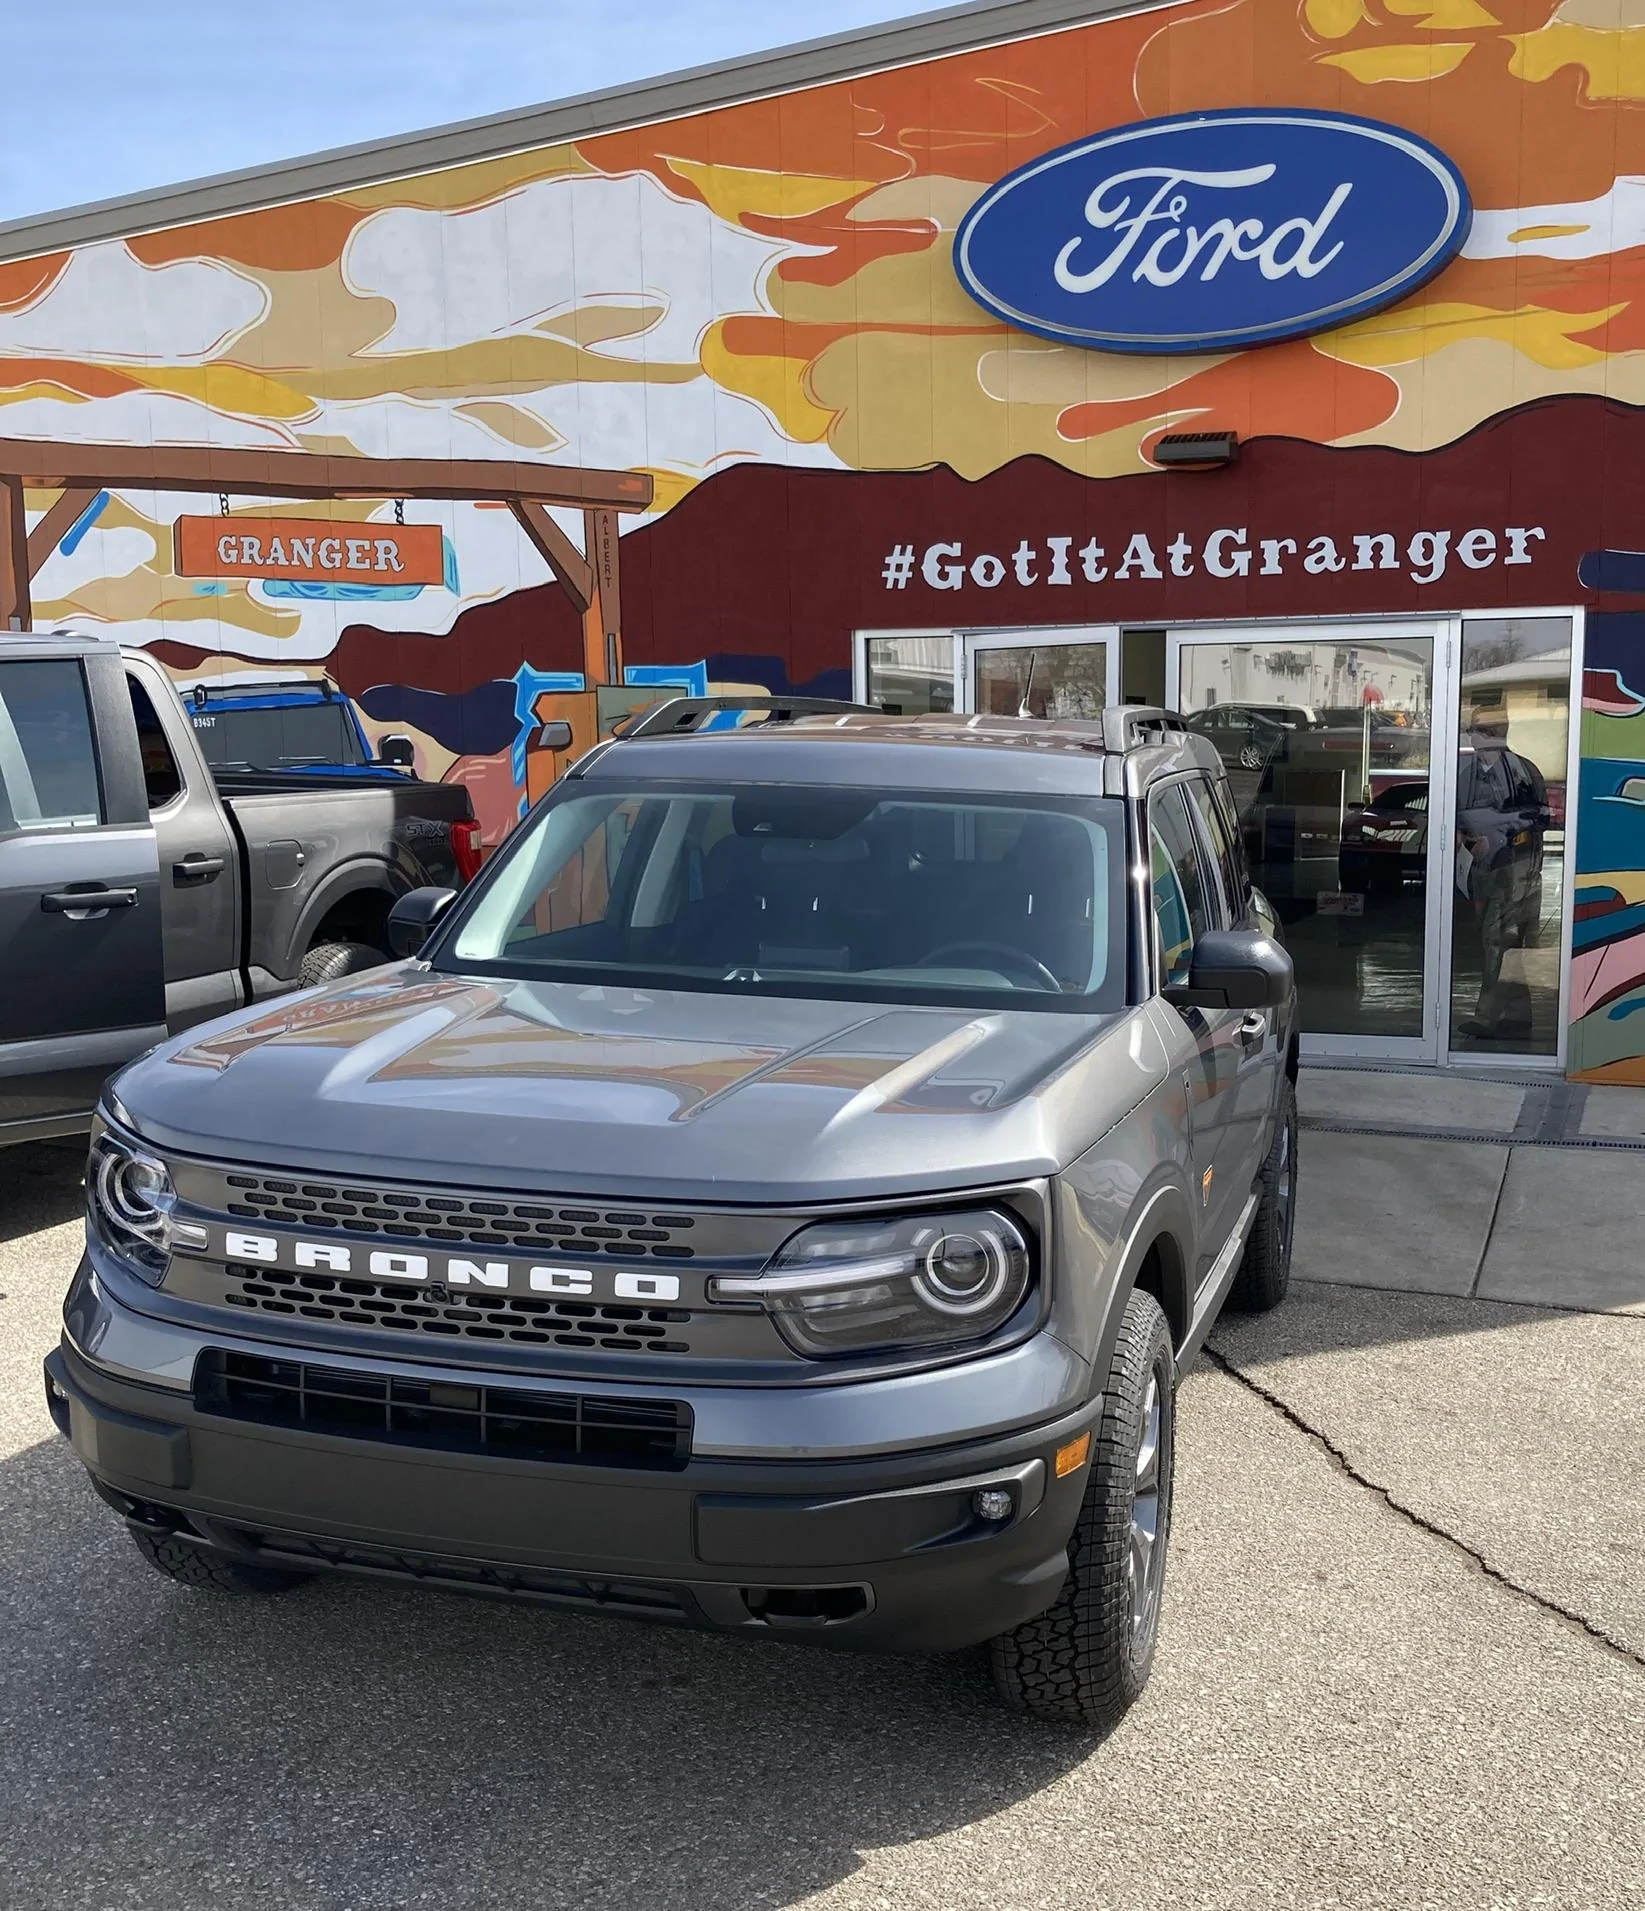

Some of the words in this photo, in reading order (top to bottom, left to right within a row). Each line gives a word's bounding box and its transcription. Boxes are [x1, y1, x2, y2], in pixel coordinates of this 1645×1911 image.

[1053, 163, 1353, 294] Ford
[217, 535, 405, 573] GRANGER
[602, 514, 612, 589] ALBERT
[881, 525, 1547, 591] #GotItAtGranger
[405, 820, 446, 839] STX
[224, 1231, 681, 1301] BRONCO
